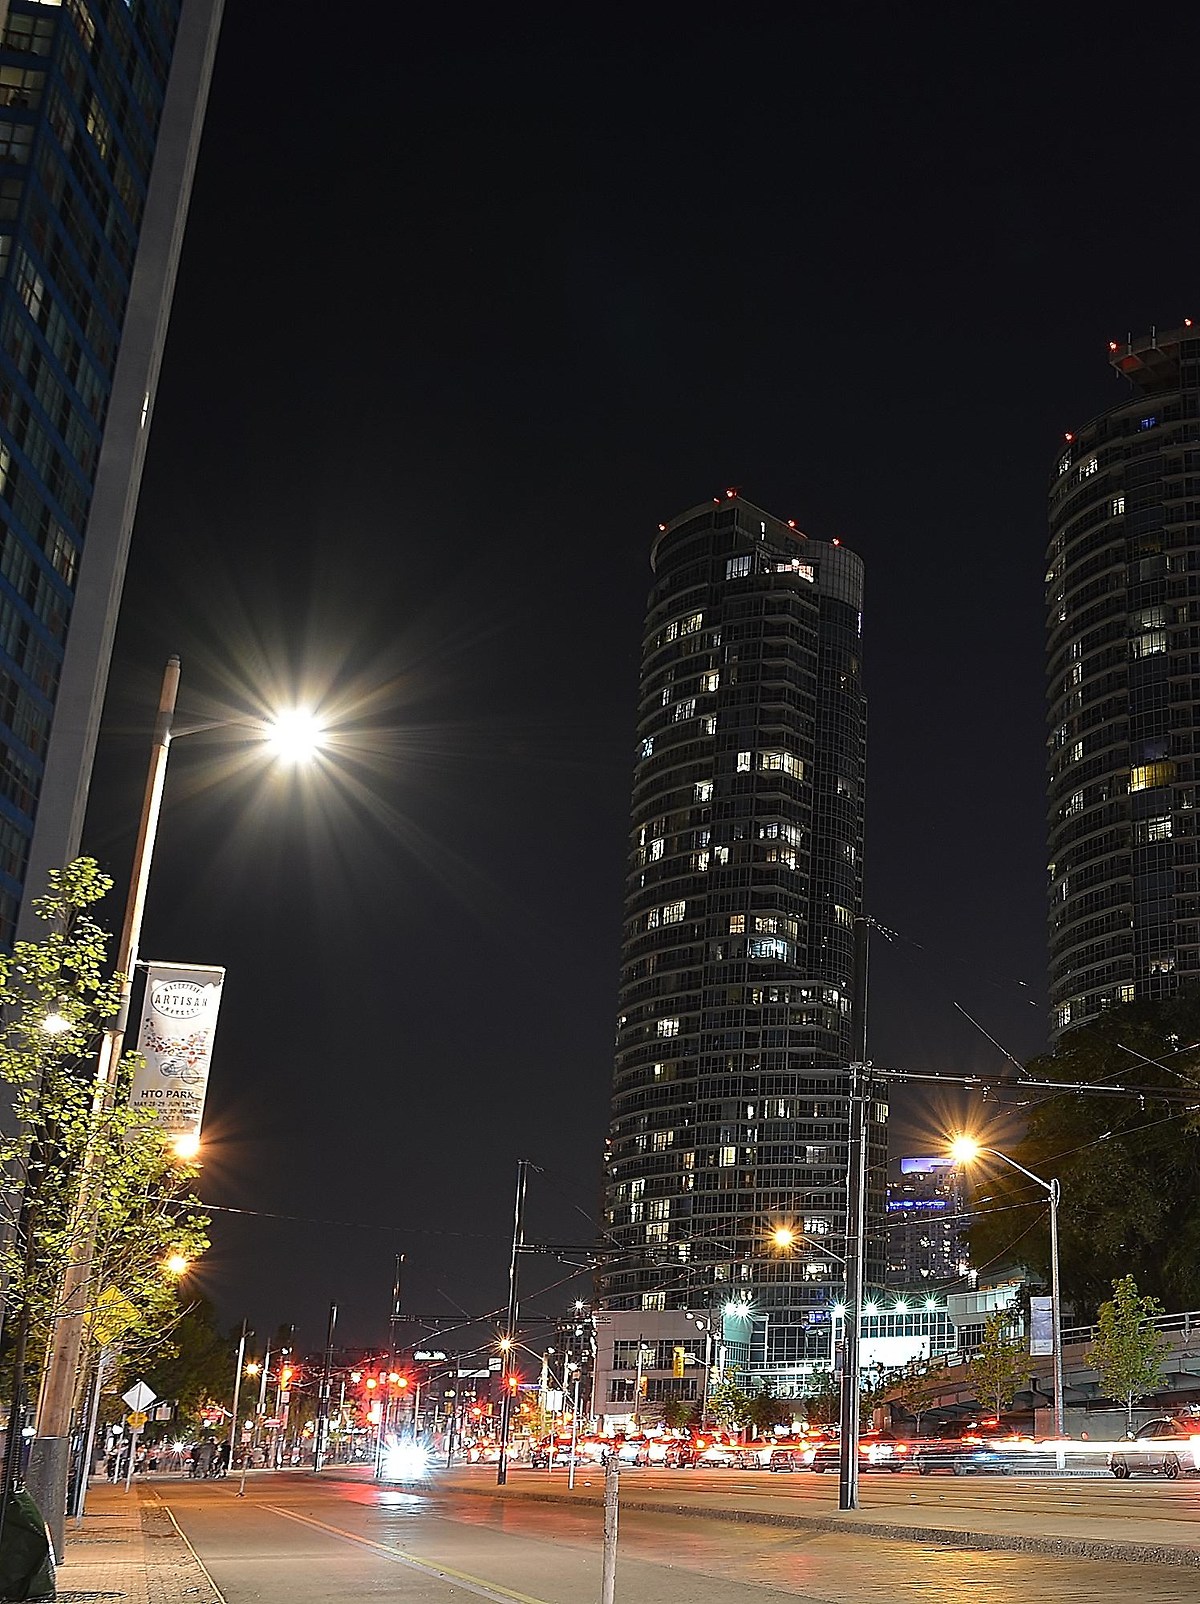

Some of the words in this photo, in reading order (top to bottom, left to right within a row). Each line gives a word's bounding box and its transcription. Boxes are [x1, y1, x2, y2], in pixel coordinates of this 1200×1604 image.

[155, 994, 208, 1007] ARTISAN
[141, 1090, 163, 1099] HTO
[166, 1090, 194, 1099] PARK
